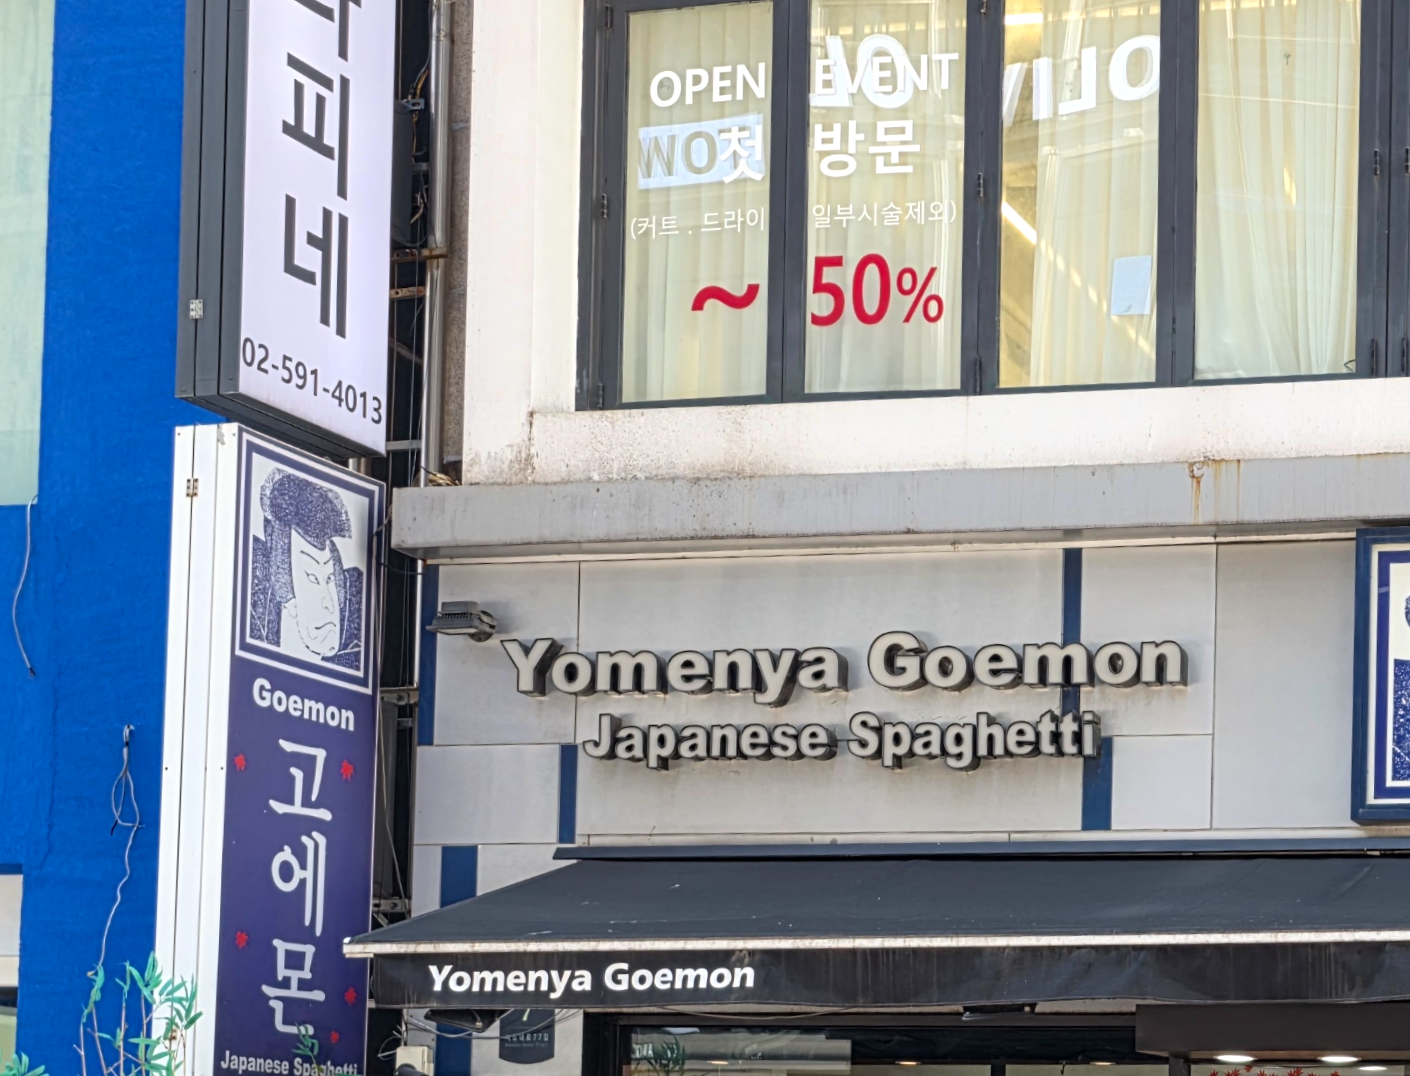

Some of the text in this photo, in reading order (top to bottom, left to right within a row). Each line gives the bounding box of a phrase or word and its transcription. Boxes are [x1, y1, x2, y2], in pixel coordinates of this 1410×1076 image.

[649, 52, 959, 108] OPEN EVENT
[281, 0, 362, 340] 피네
[719, 119, 921, 184] 첫 방문
[700, 207, 767, 236] 드라이
[812, 200, 957, 229] 일부시술제외)
[810, 252, 944, 327] 50%
[242, 337, 383, 425] 02-591-4013
[500, 629, 1189, 709] Yomenya Goemon
[252, 677, 355, 732] Goemon
[582, 709, 1102, 772] Japanese Spaghetti
[261, 738, 333, 1036] 고에몬
[428, 962, 755, 999] Yomenya Goemon
[220, 1050, 290, 1075] Japanese
